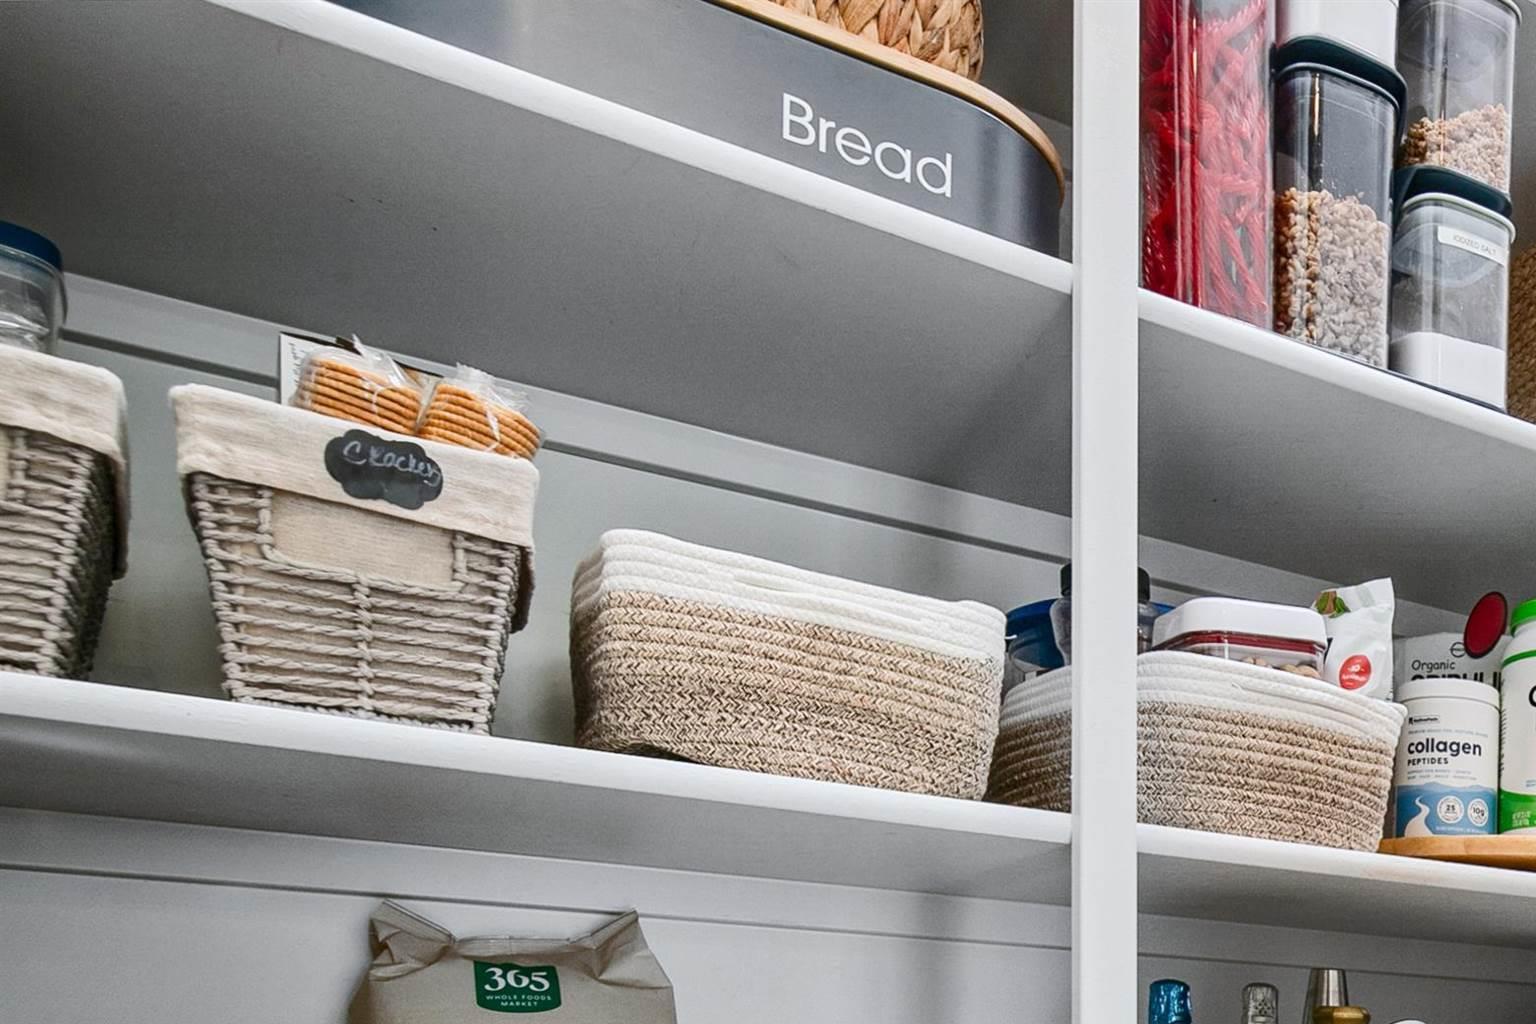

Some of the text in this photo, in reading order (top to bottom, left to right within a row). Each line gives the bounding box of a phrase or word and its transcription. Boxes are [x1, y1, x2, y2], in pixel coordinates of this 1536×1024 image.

[782, 92, 953, 198] Bread
[1411, 659, 1456, 673] Organic
[1407, 738, 1482, 757] collagen
[1407, 757, 1449, 767] PEPTIDES
[484, 967, 550, 992] 365
